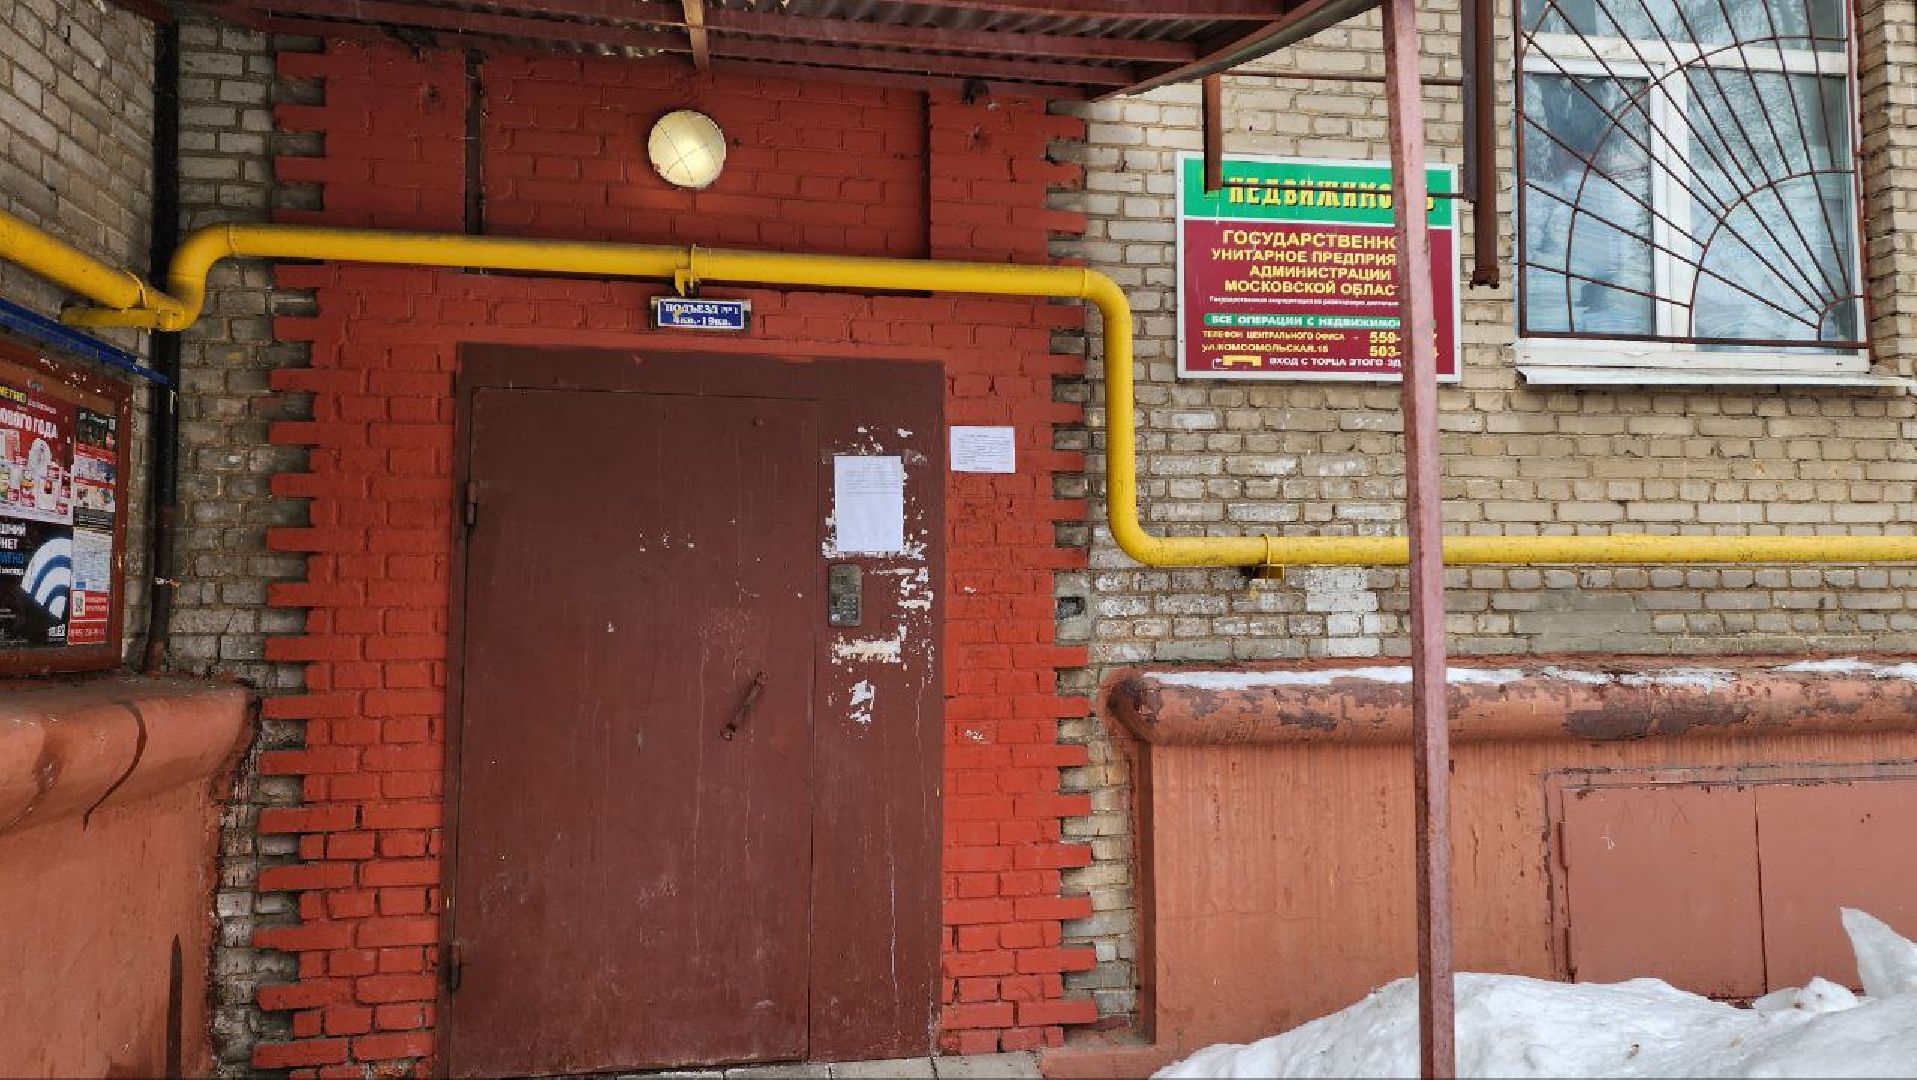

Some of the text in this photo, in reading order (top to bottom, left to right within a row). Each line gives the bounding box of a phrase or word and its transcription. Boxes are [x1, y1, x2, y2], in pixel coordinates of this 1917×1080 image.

[1229, 178, 1435, 210] НЕДВИЖИМО
[1211, 248, 1398, 266] УНИТАРНОЕ ПРЕДПРИЯ
[1249, 265, 1392, 281] АДМИНИСТРАЦИИ
[1224, 279, 1399, 298] МОСКОВСКОЙ ОБЛАС
[1212, 315, 1233, 324] ВСЕ
[1237, 316, 1303, 326] ОПЕРАЦИИ
[1202, 330, 1243, 339] ТЕЛЕФОН
[1246, 331, 1314, 341] ЦЕНТРАЛЬНОГО
[1269, 357, 1298, 367] ВХОД
[1301, 358, 1309, 366] С
[1311, 358, 1346, 367] ТОРЦА
[1348, 358, 1383, 367] ЭТОГО
